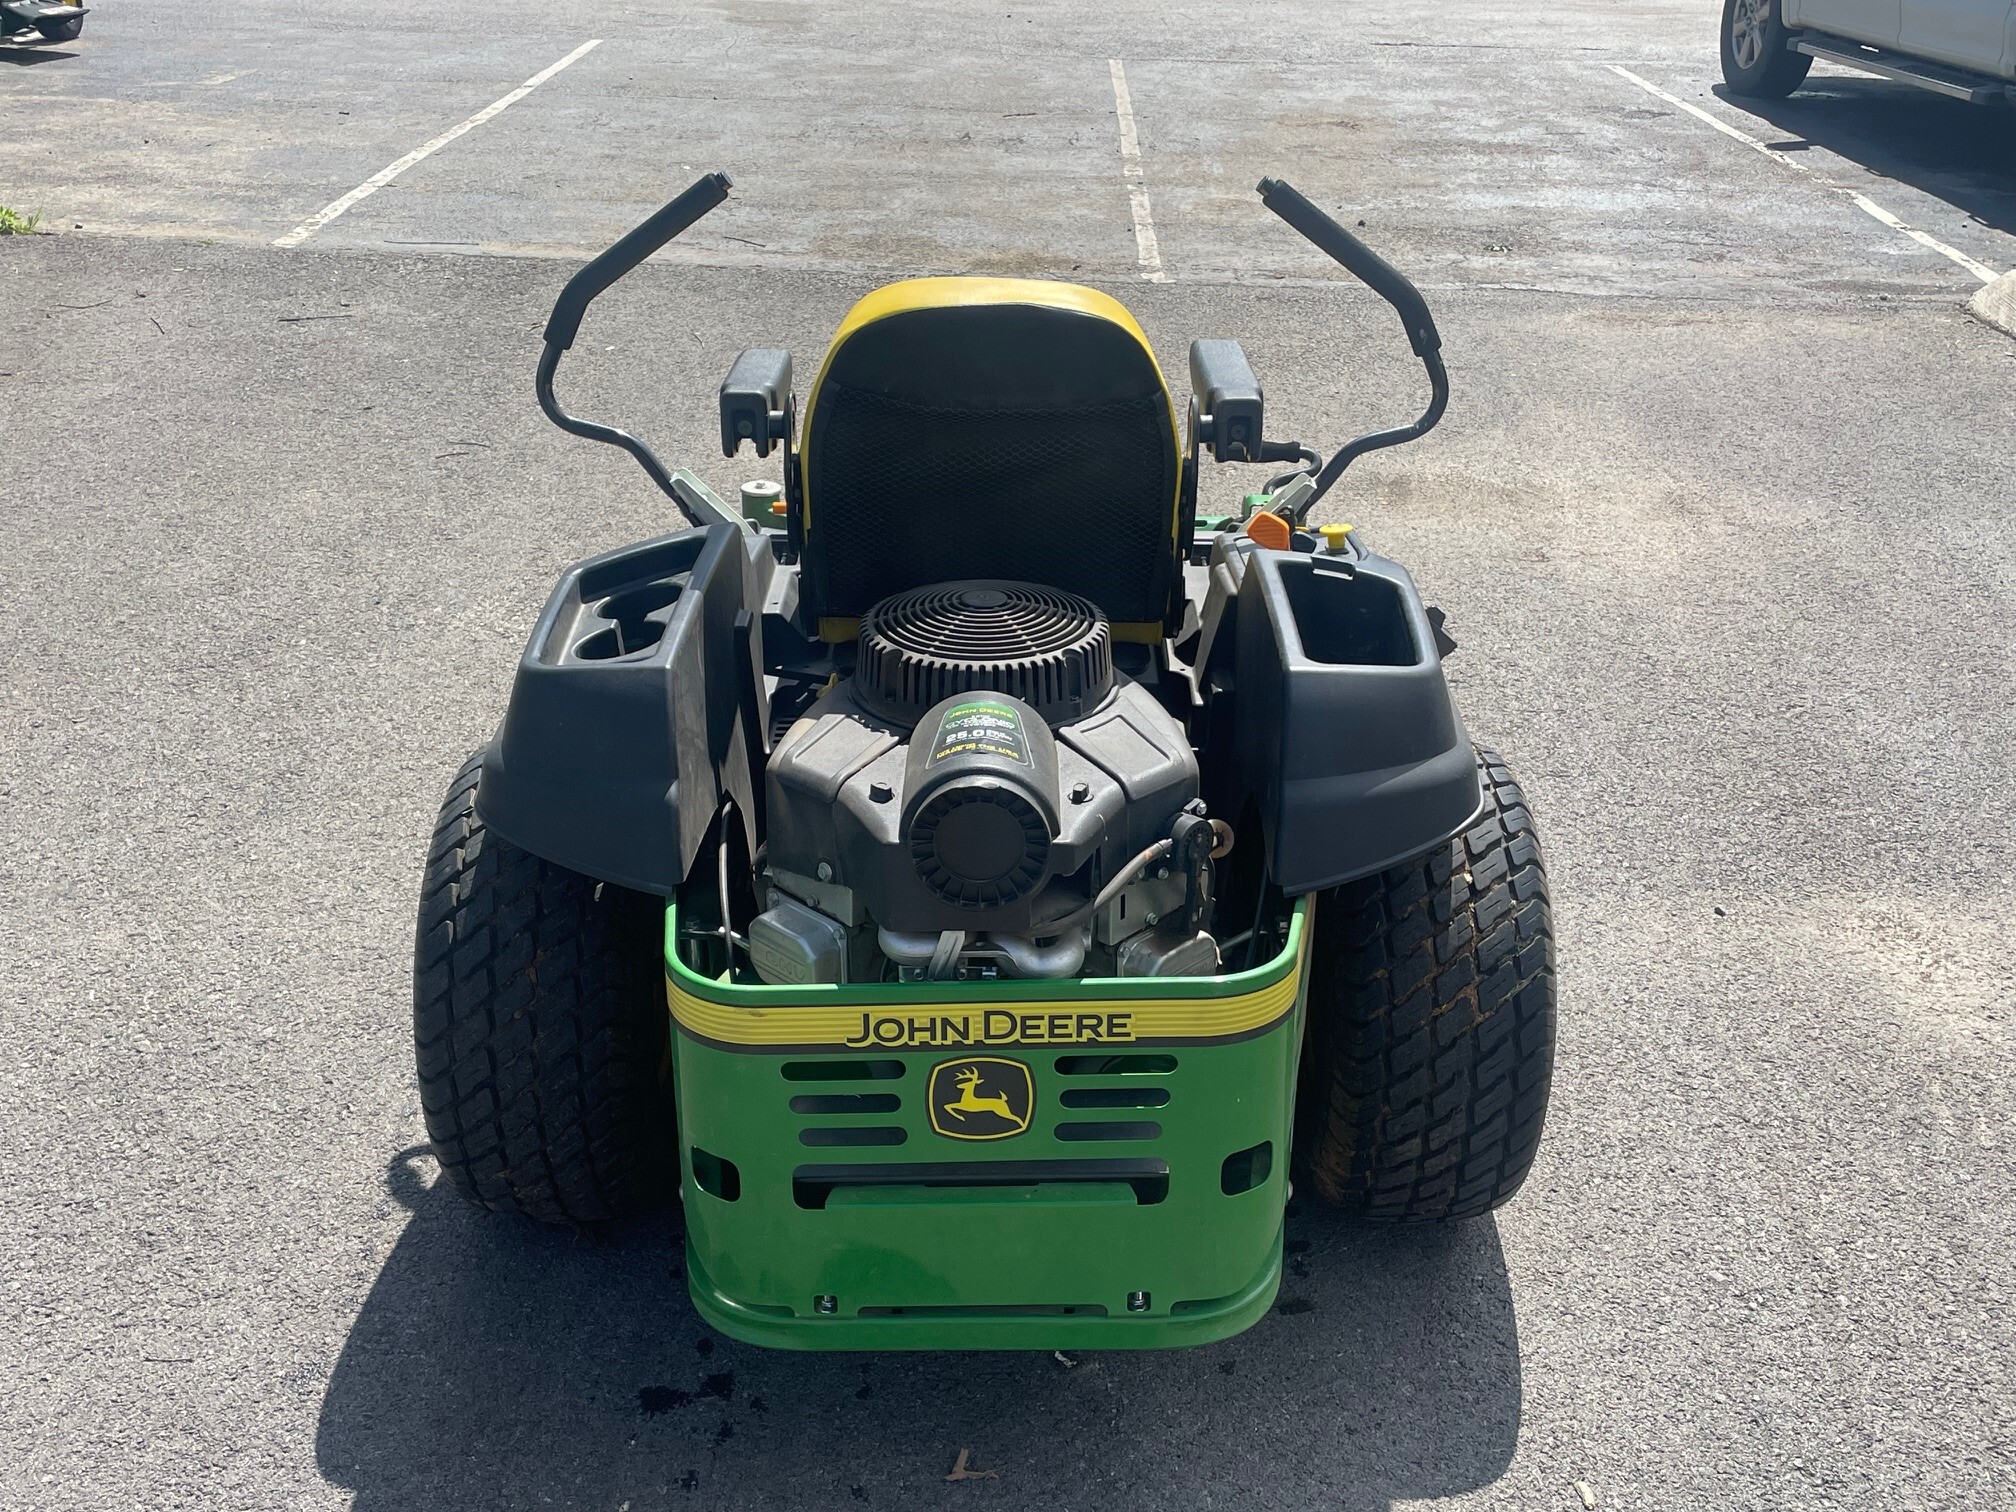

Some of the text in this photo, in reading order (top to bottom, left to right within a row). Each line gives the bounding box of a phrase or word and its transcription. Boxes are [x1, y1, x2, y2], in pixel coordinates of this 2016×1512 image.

[949, 708, 976, 718] JOHN
[978, 707, 1013, 719] DEERE
[946, 729, 984, 743] 25.0
[846, 1010, 1132, 1044] JOHN DEERE
